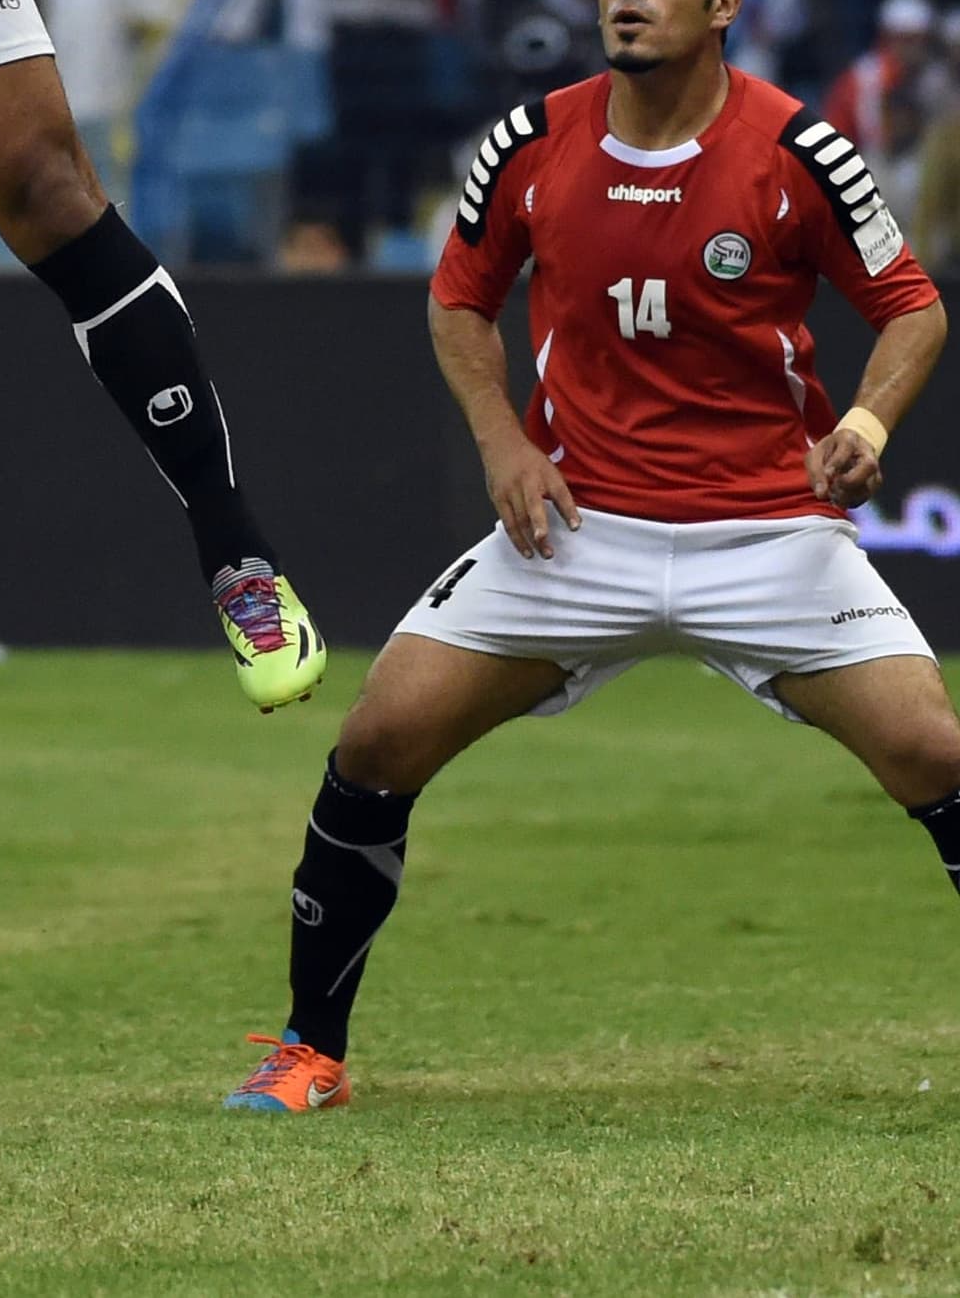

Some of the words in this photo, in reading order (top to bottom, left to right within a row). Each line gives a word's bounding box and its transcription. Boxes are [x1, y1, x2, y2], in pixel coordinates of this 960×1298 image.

[607, 184, 682, 205] uhlsport
[607, 277, 672, 340] 14
[831, 606, 898, 625] uhlsport
